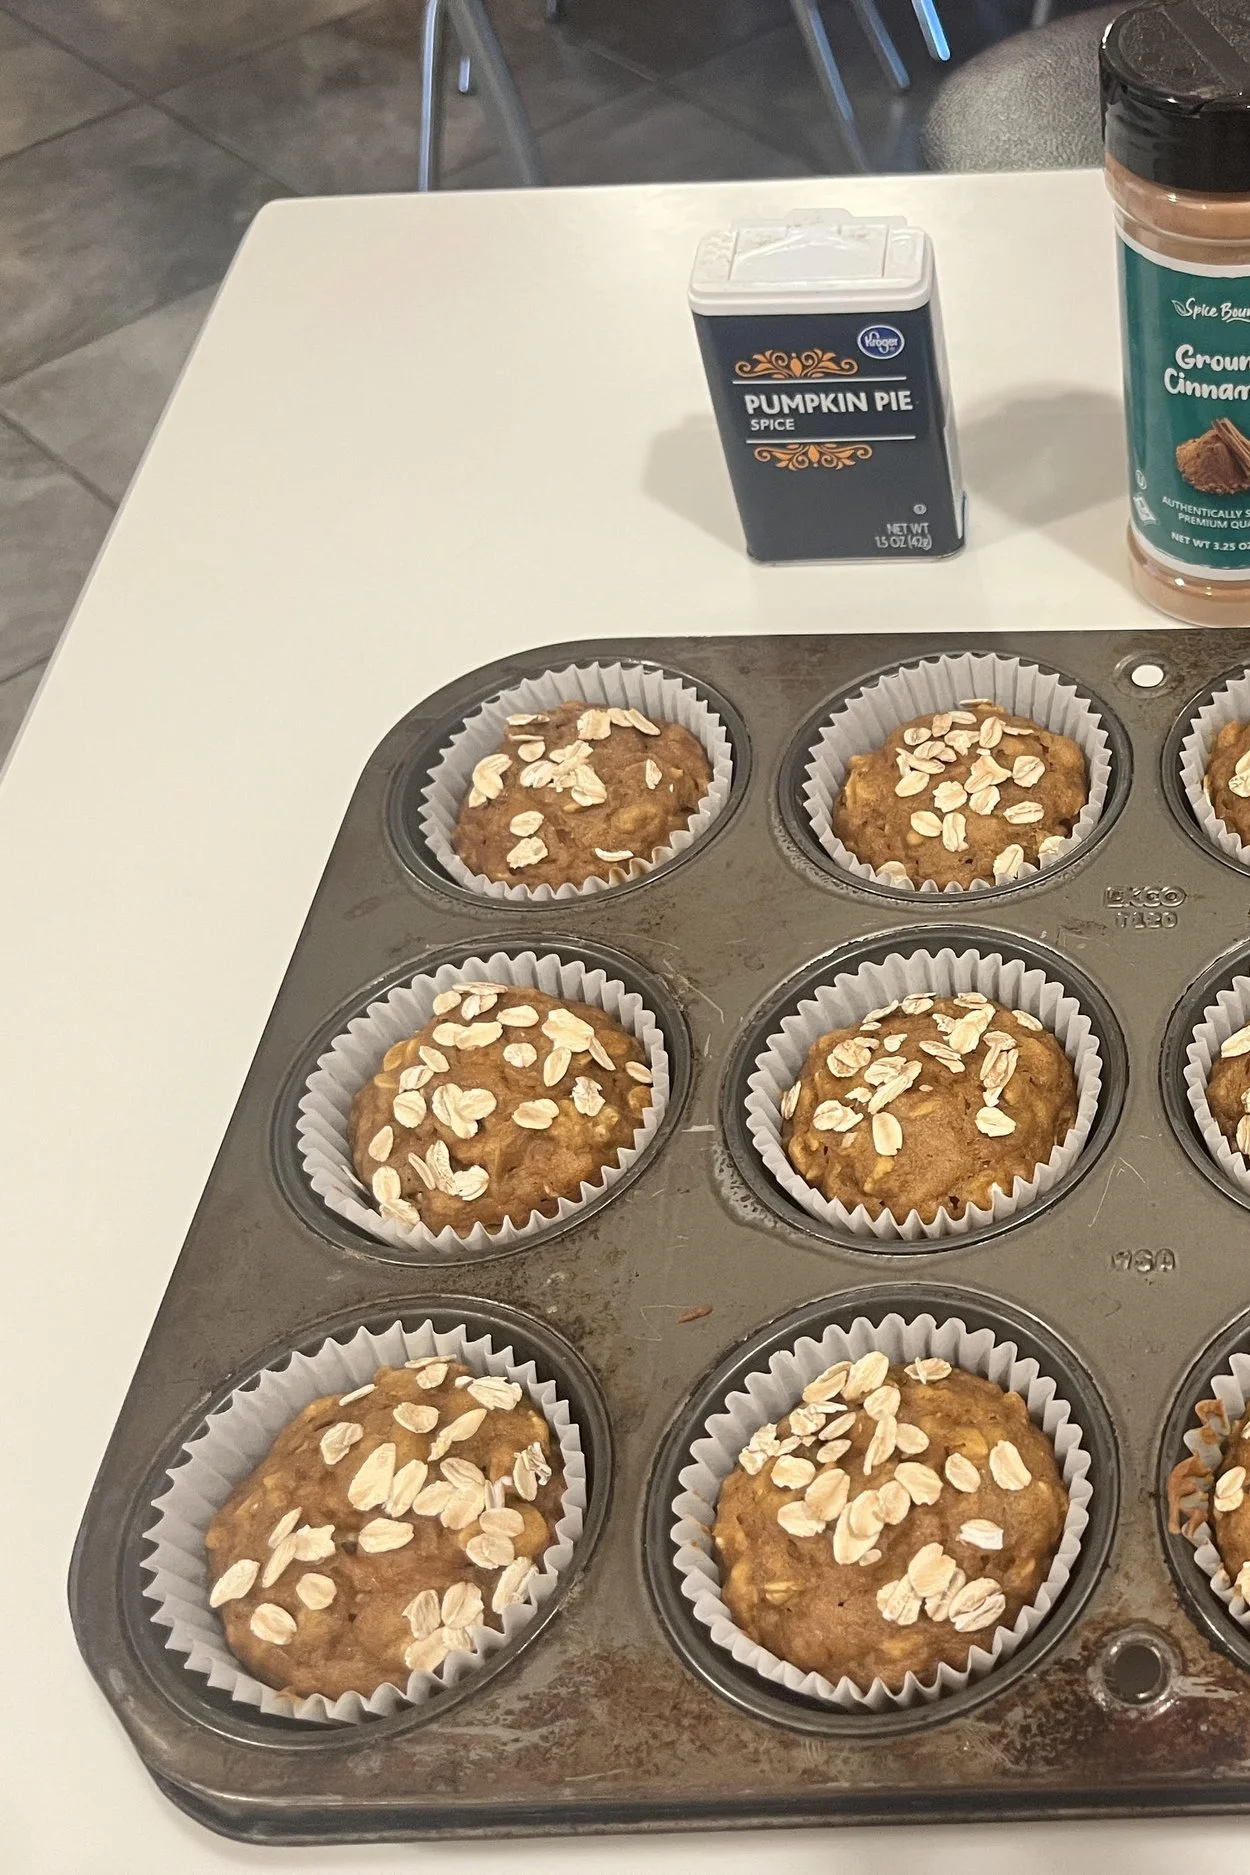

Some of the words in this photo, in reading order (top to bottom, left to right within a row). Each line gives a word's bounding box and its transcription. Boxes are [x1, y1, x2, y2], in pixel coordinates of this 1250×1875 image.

[1185, 298, 1218, 320] Spice
[864, 331, 898, 354] Kroger
[744, 392, 868, 415] PUMPKIN
[874, 390, 913, 412] PIE
[750, 418, 795, 431] SPICE
[1162, 496, 1242, 519] AUTHENTICALLY
[886, 523, 908, 535] NET
[909, 522, 929, 534] WT
[1178, 512, 1228, 529] PREMIUM
[890, 536, 907, 548] OZ
[1171, 531, 1190, 545] NET
[1192, 538, 1210, 549] WT
[1213, 542, 1236, 551] 3.25
